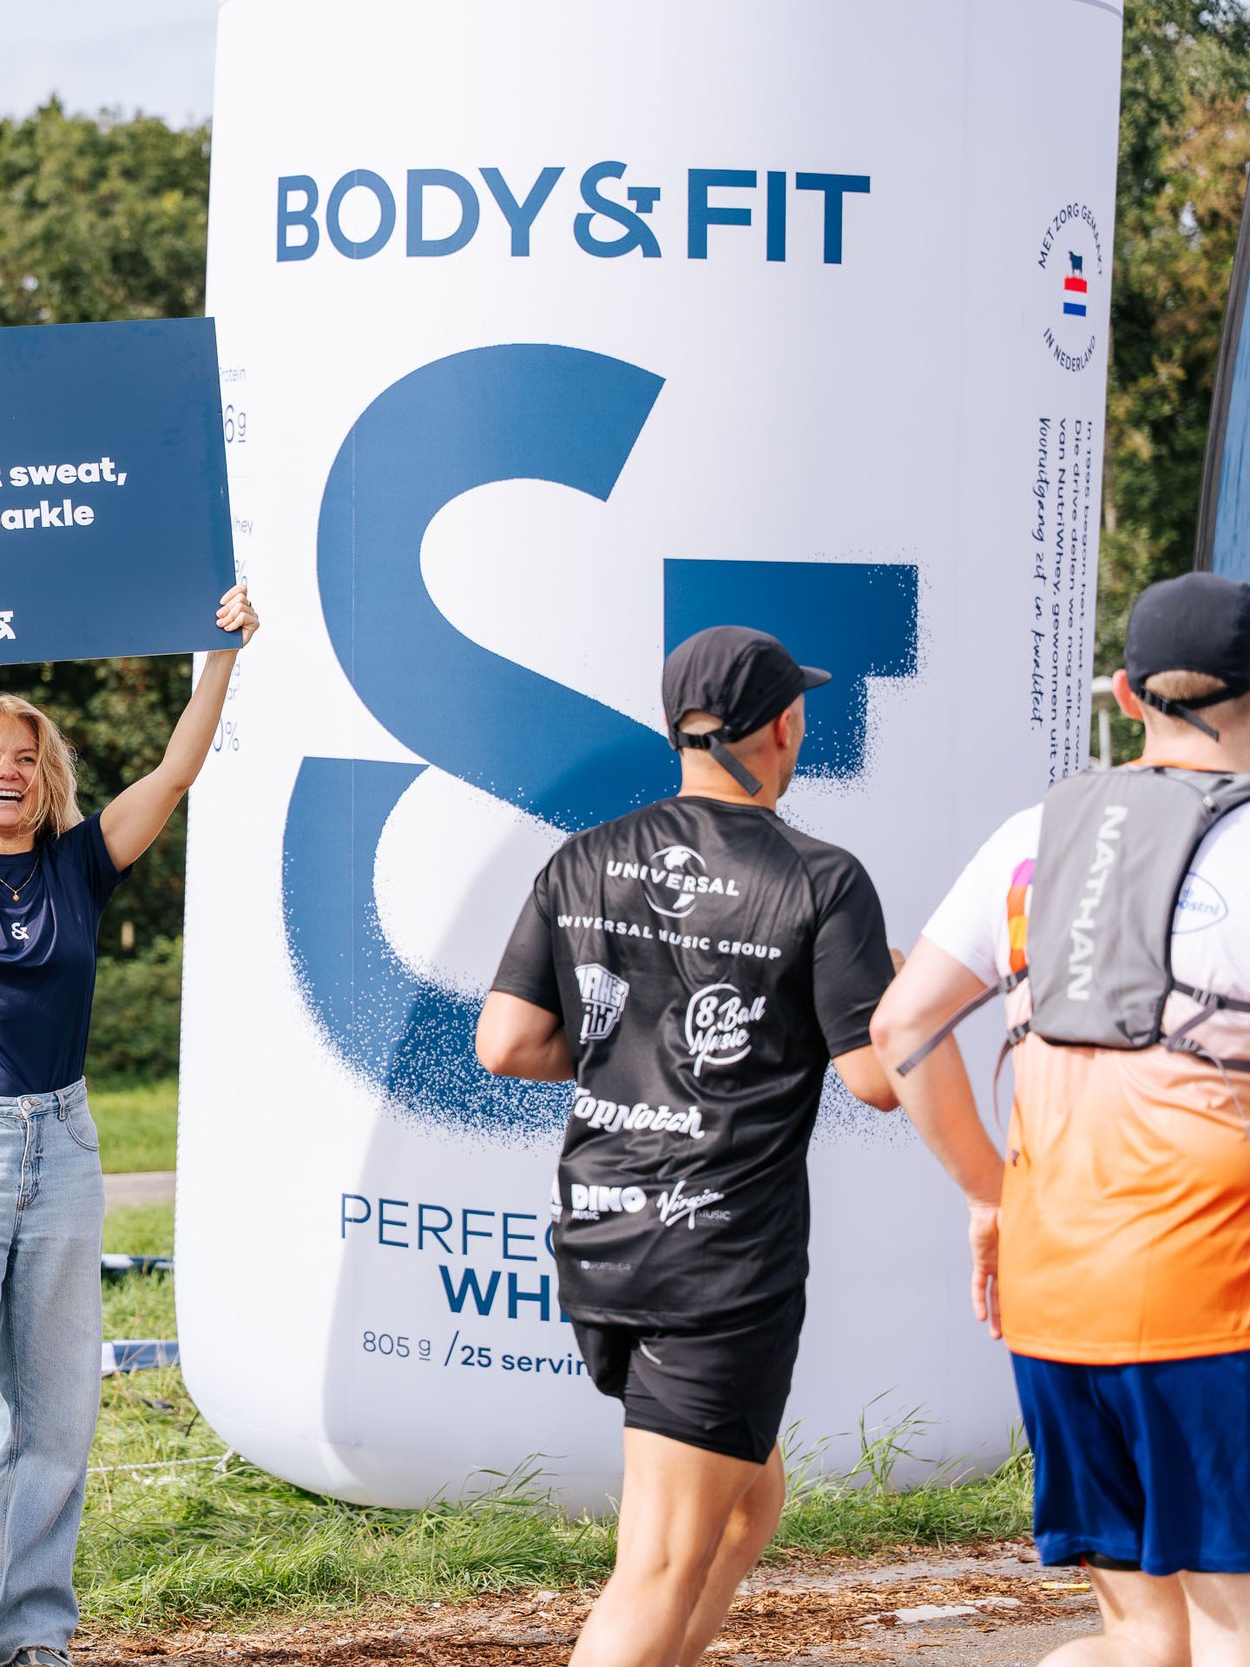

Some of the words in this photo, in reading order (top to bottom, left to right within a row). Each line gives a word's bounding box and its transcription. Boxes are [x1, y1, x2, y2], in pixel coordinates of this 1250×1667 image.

[276, 160, 871, 265] BODY&FIT
[1038, 227, 1055, 270] MET
[1052, 202, 1080, 232] ZORG
[1043, 327, 1055, 349] IN
[1053, 335, 1096, 372] NEDERLAND
[1058, 418, 1067, 460] van
[1073, 420, 1082, 457] Die
[9, 456, 128, 487] sweat,
[1032, 417, 1051, 542] Vooruitgang
[1071, 463, 1080, 521] drive
[1052, 468, 1066, 596] NutriWhey,
[1034, 552, 1047, 586] zit
[1069, 528, 1078, 590] delen
[1034, 596, 1044, 621] in
[1067, 598, 1074, 629] we
[1050, 603, 1060, 721] gewonnen
[1065, 636, 1073, 677] nog
[1064, 685, 1073, 730] elke
[1049, 728, 1059, 759] uit
[606, 860, 740, 897] UNIVERSAL
[1066, 805, 1128, 1001] NATHAN
[11, 922, 30, 940] &
[695, 995, 719, 1028] 8
[716, 995, 766, 1032] Ball
[688, 1025, 750, 1077] Music
[341, 1192, 558, 1262] PERFE
[571, 1183, 647, 1213] DINO
[656, 1180, 725, 1230] Virgin
[571, 1210, 600, 1220] MUSIC
[696, 1209, 731, 1221] MUSIC
[438, 1264, 572, 1323] WH
[363, 1330, 410, 1358] 805
[502, 1353, 592, 1377] servin
